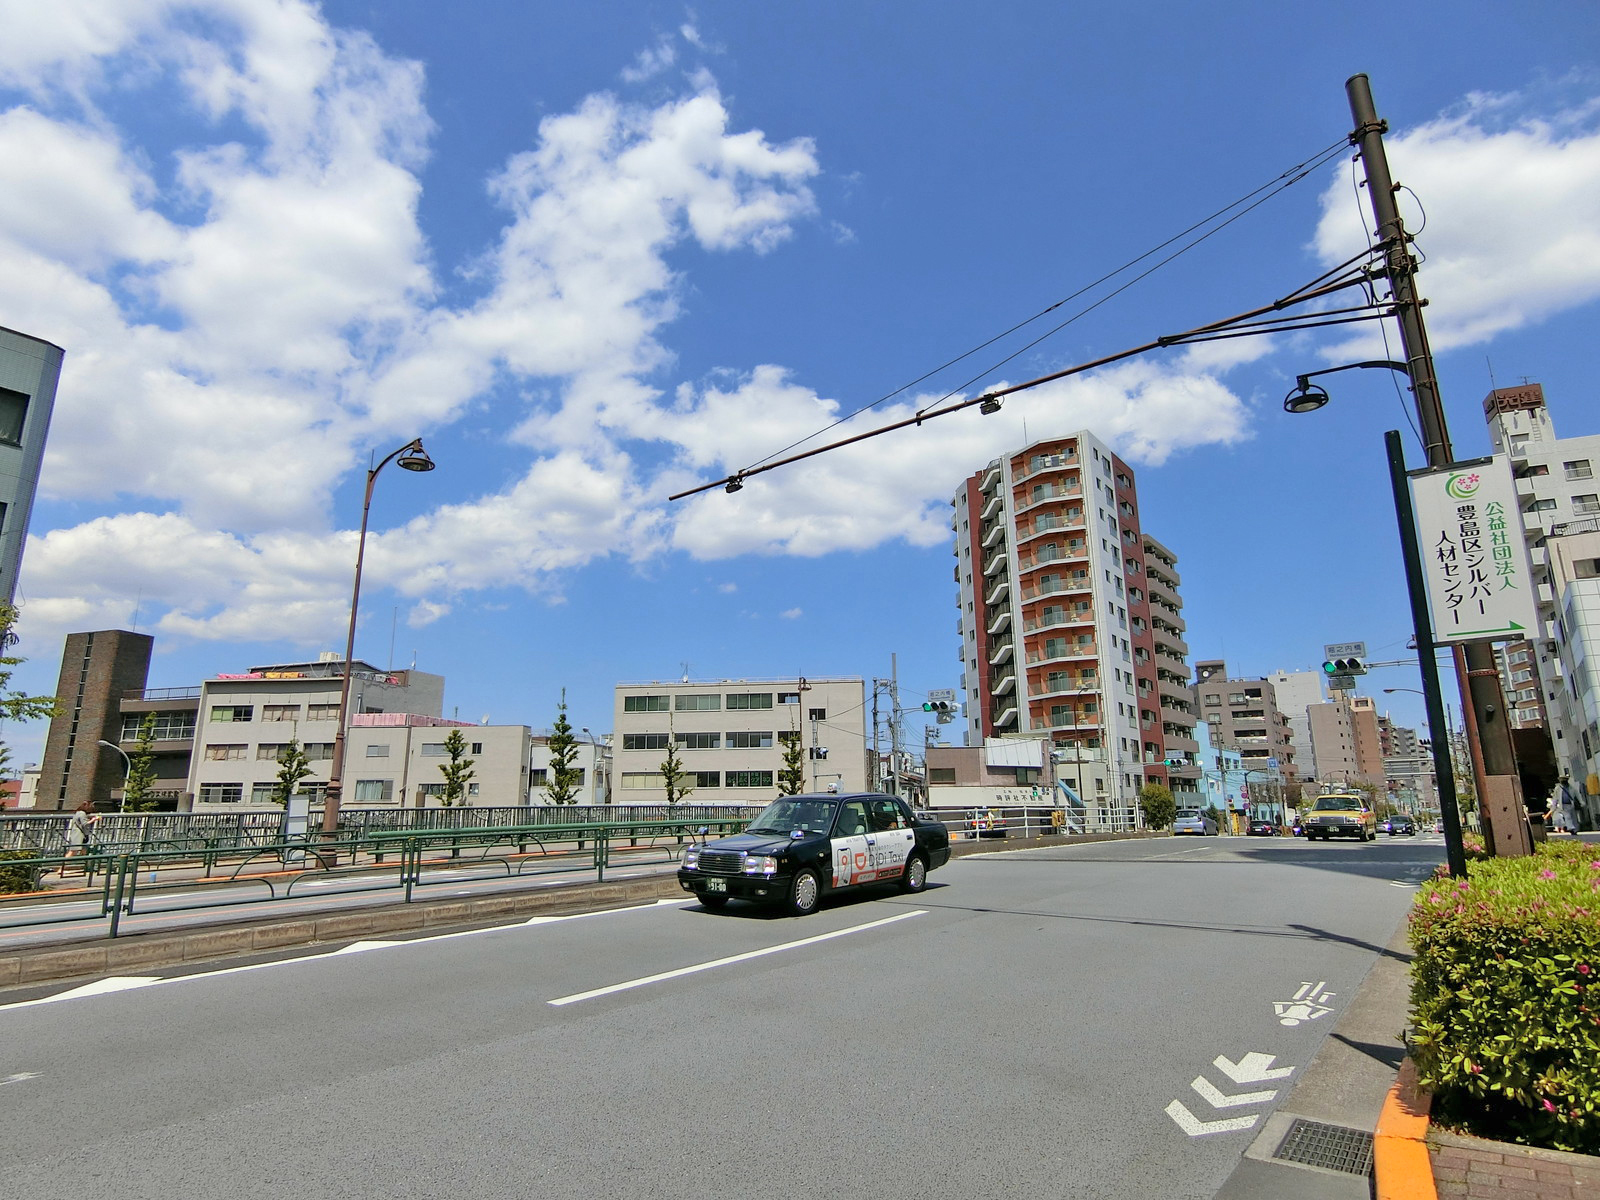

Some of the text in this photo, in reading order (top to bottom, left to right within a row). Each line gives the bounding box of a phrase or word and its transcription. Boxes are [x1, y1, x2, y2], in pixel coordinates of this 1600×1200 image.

[1435, 530, 1464, 625] 人材センター
[1456, 504, 1492, 615] 豊島区シルバー
[1485, 501, 1518, 591] 公益社団法人
[869, 849, 904, 867] DiDi Taxi
